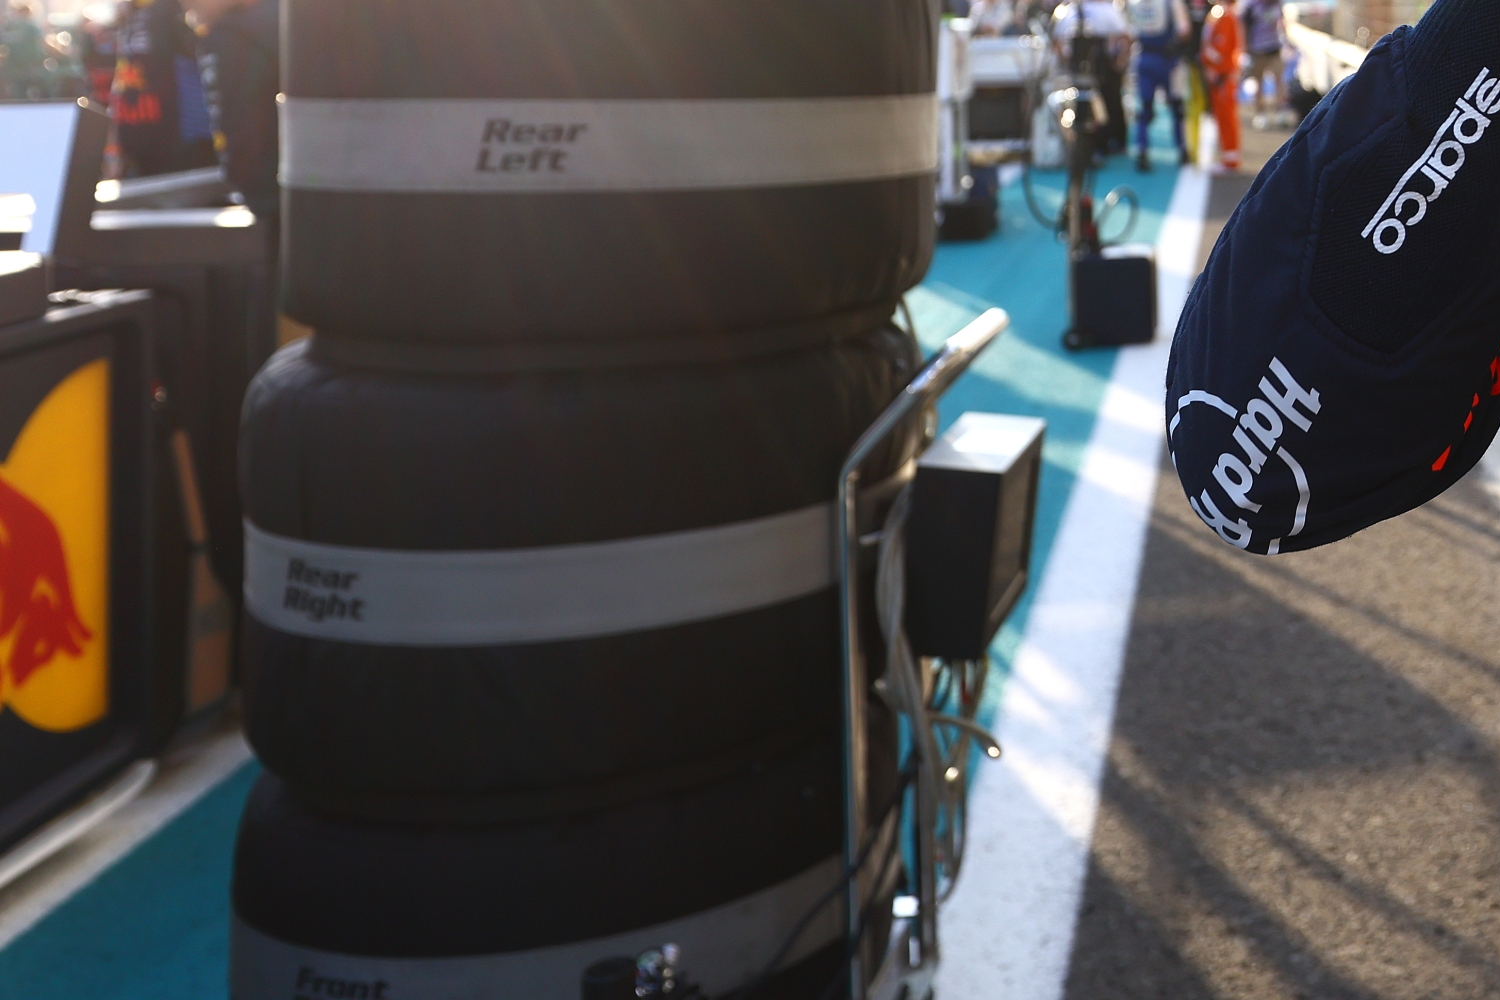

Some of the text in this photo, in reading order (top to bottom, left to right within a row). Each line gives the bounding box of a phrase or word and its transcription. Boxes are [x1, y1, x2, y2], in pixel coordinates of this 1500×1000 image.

[480, 118, 588, 145] Rear
[475, 147, 569, 174] Left
[1208, 356, 1322, 514] Hard
[285, 558, 360, 591] Rear
[282, 588, 365, 622] Right
